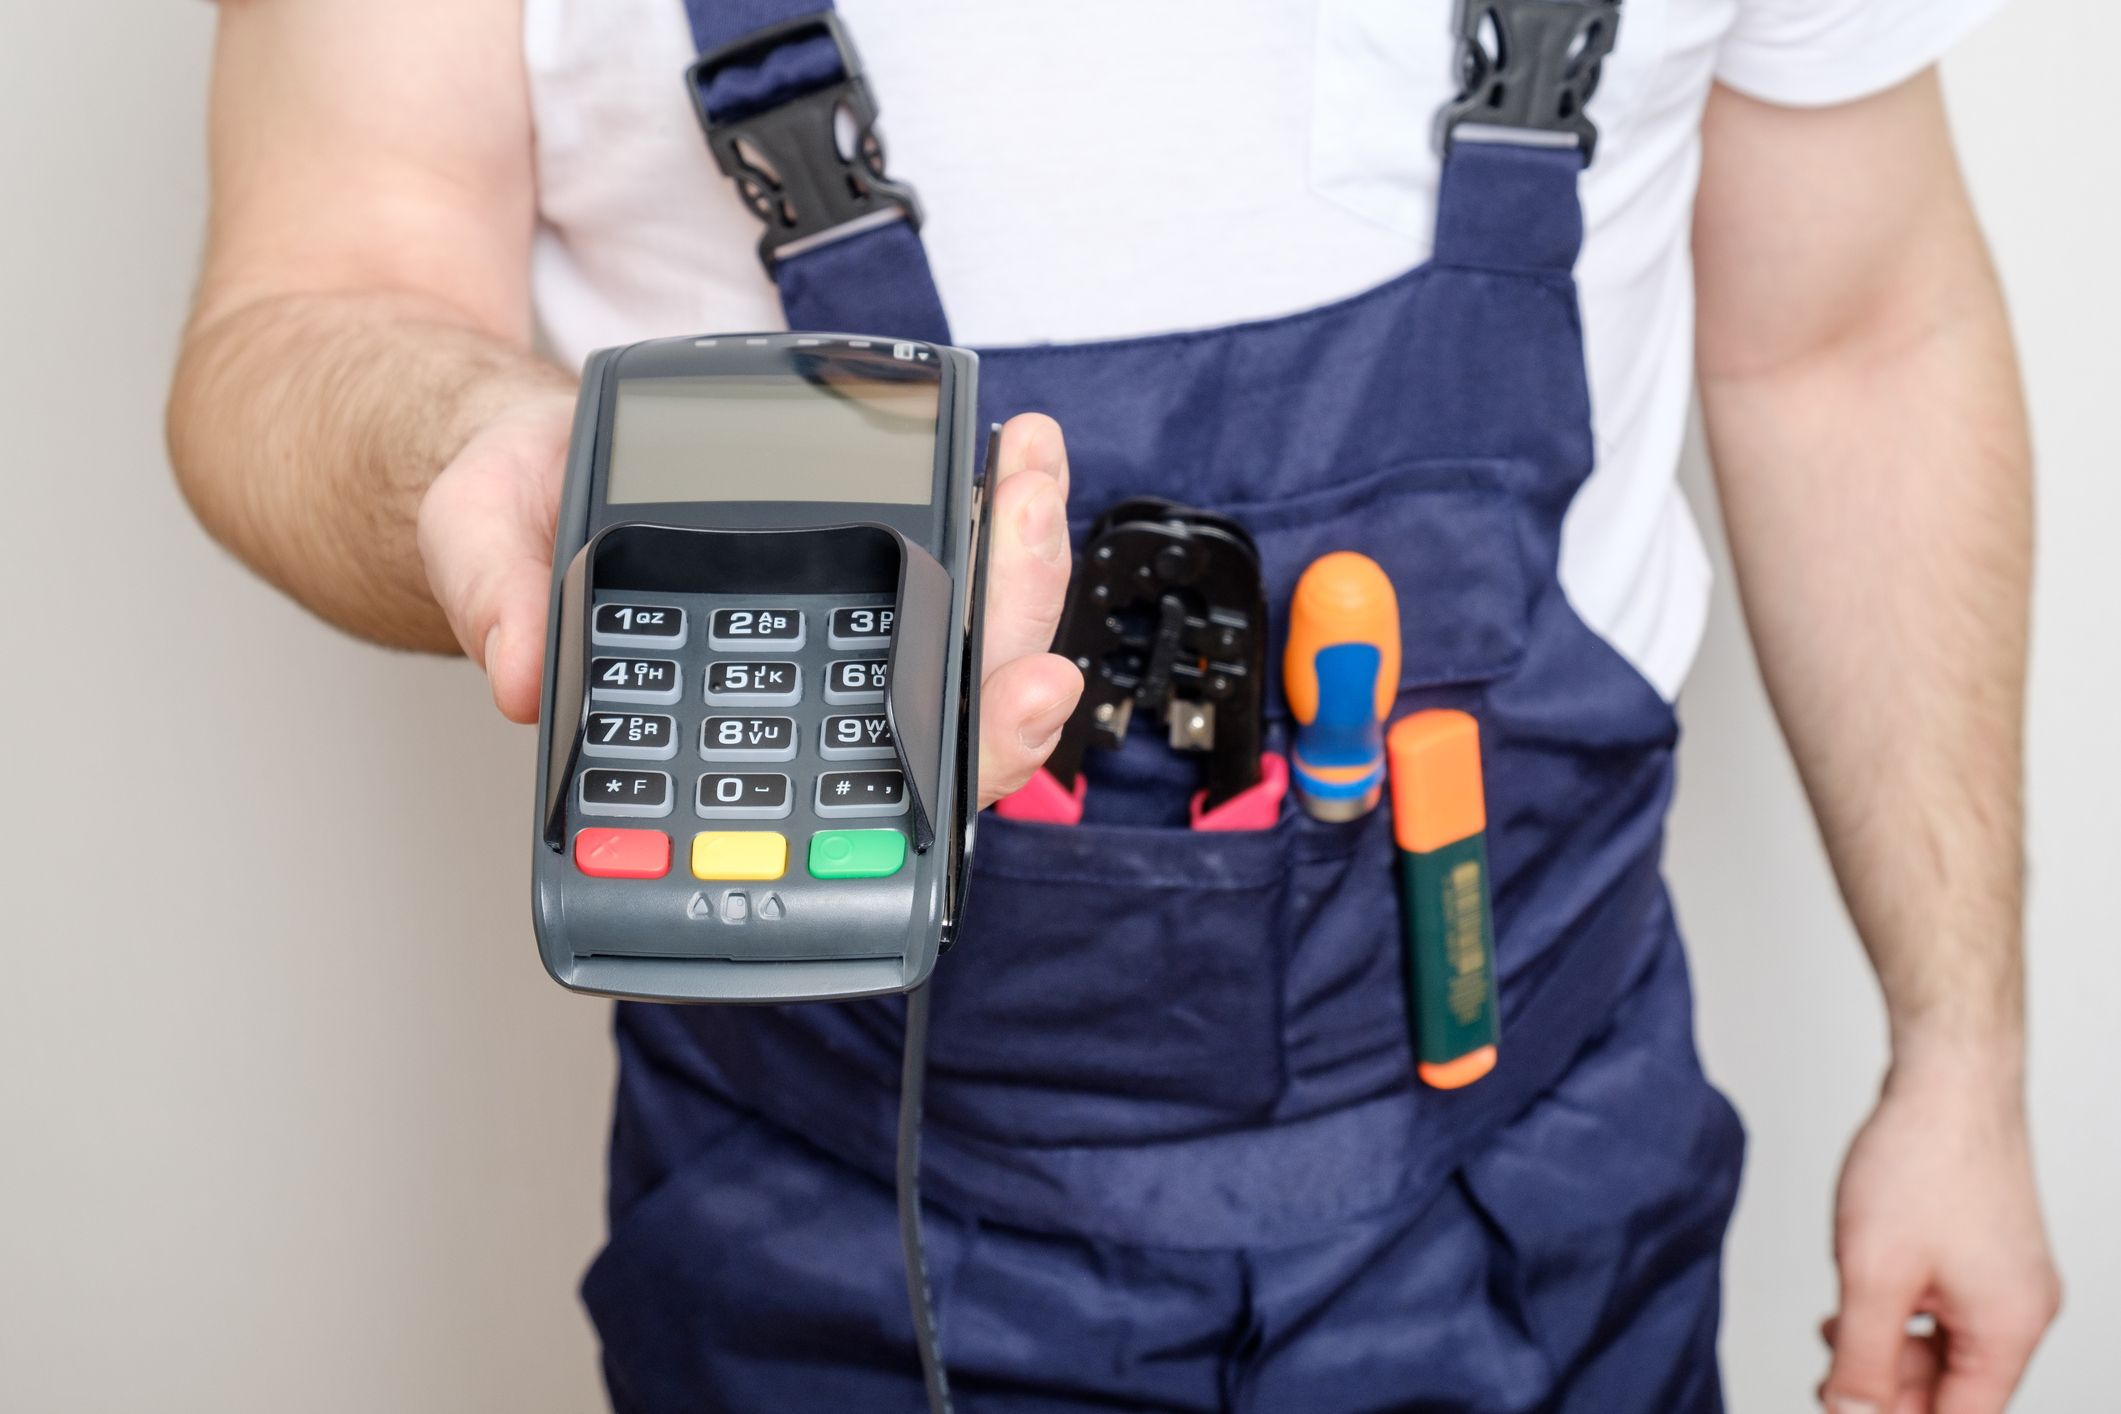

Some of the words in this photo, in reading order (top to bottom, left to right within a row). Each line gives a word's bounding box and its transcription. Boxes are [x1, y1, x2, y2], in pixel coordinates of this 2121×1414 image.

[614, 608, 633, 630] 1
[729, 612, 753, 634] 2
[850, 610, 874, 632] 3
[602, 662, 629, 685] 4
[725, 665, 749, 688] 5
[842, 664, 866, 687] 6
[599, 718, 624, 742] 7
[718, 721, 743, 745] 8
[837, 718, 862, 743] 9
